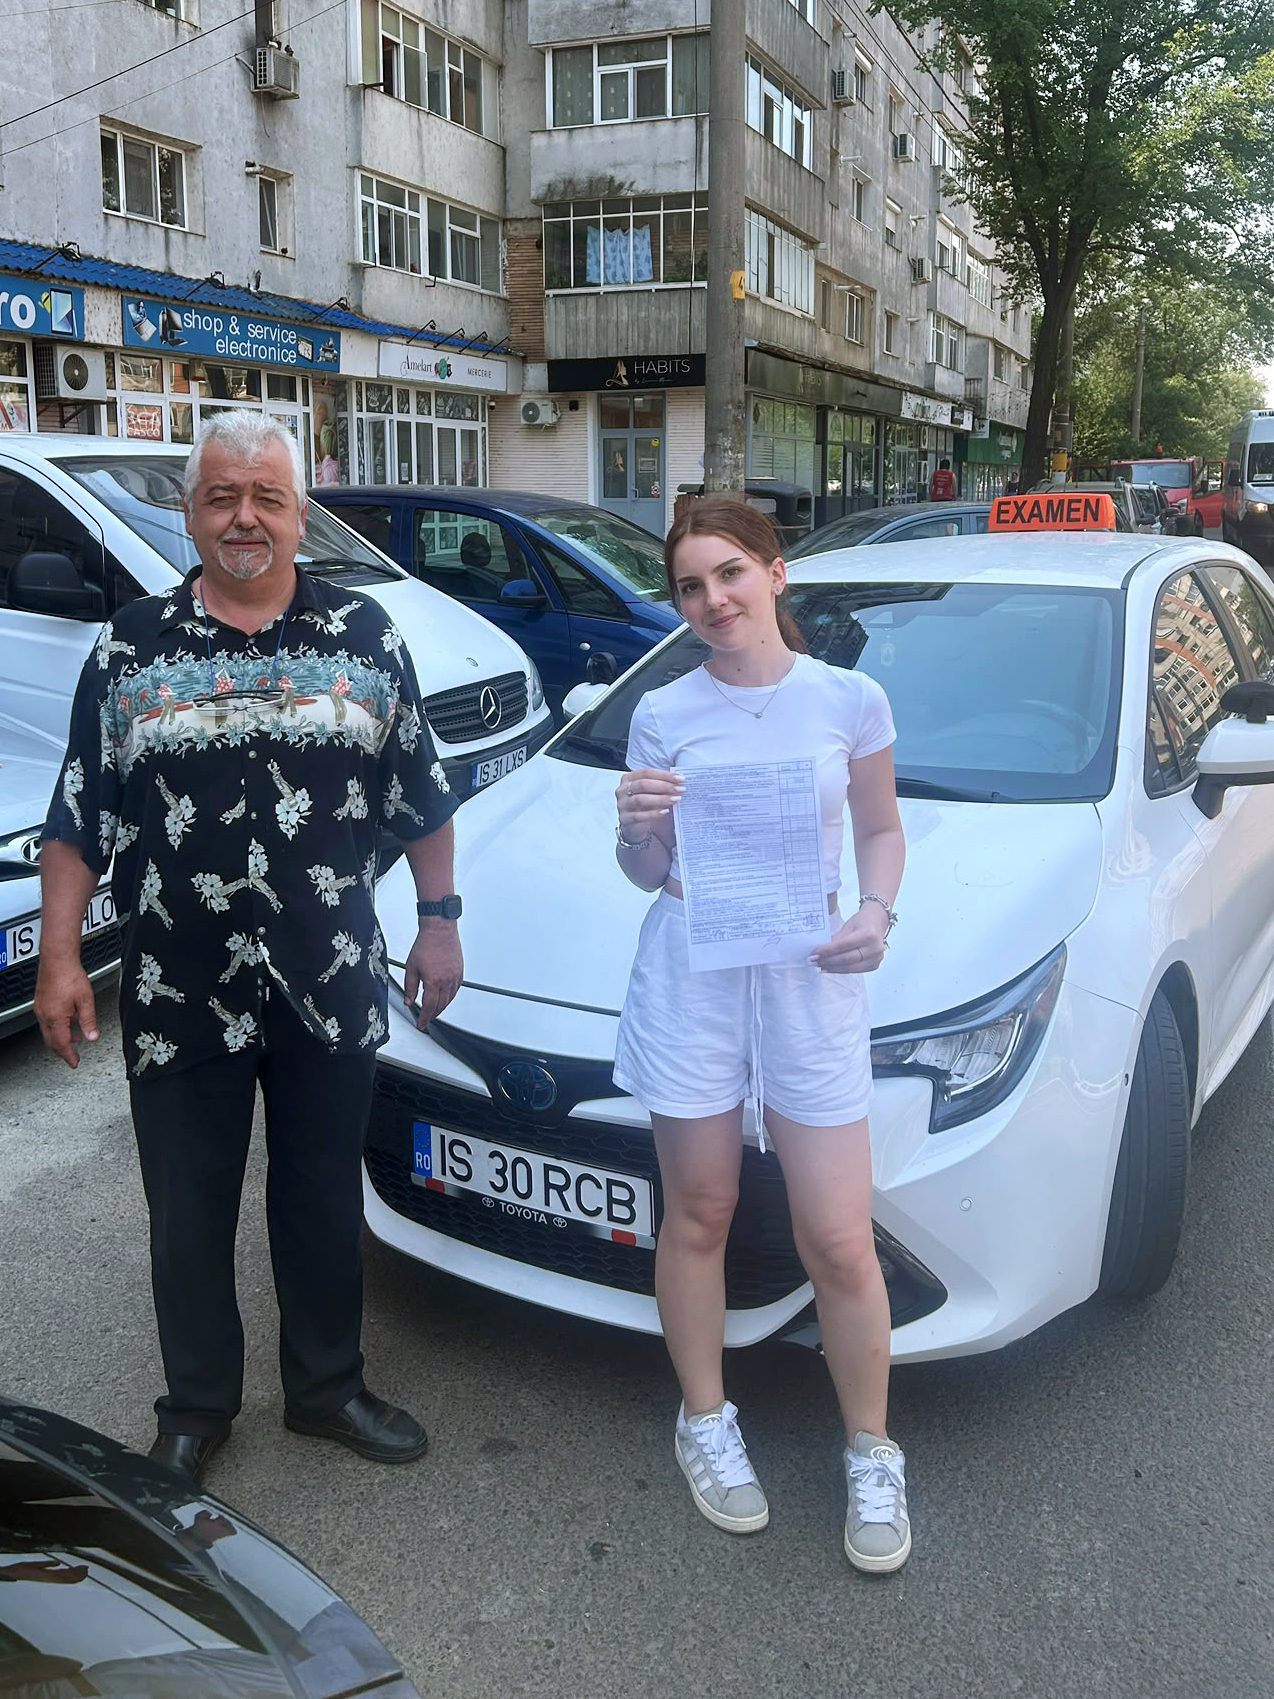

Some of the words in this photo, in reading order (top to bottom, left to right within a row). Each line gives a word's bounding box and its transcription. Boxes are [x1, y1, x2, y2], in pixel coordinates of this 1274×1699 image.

[183, 309, 223, 337] shop
[228, 315, 241, 335] &
[247, 322, 297, 344] service
[215, 335, 297, 364] electronice
[400, 350, 432, 376] Amelart
[467, 367, 492, 379] MERCERIE
[634, 359, 691, 374] HABITS
[996, 498, 1100, 524] EXAMEN
[479, 763, 490, 784] IS
[492, 758, 503, 780] 31
[505, 749, 524, 773] LXS
[13, 926, 34, 960] IS
[415, 1151, 431, 1171] RO
[439, 1133, 473, 1183] IS
[488, 1149, 533, 1200] 30
[543, 1162, 637, 1226] RCB
[498, 1201, 548, 1225] TOYOTA
